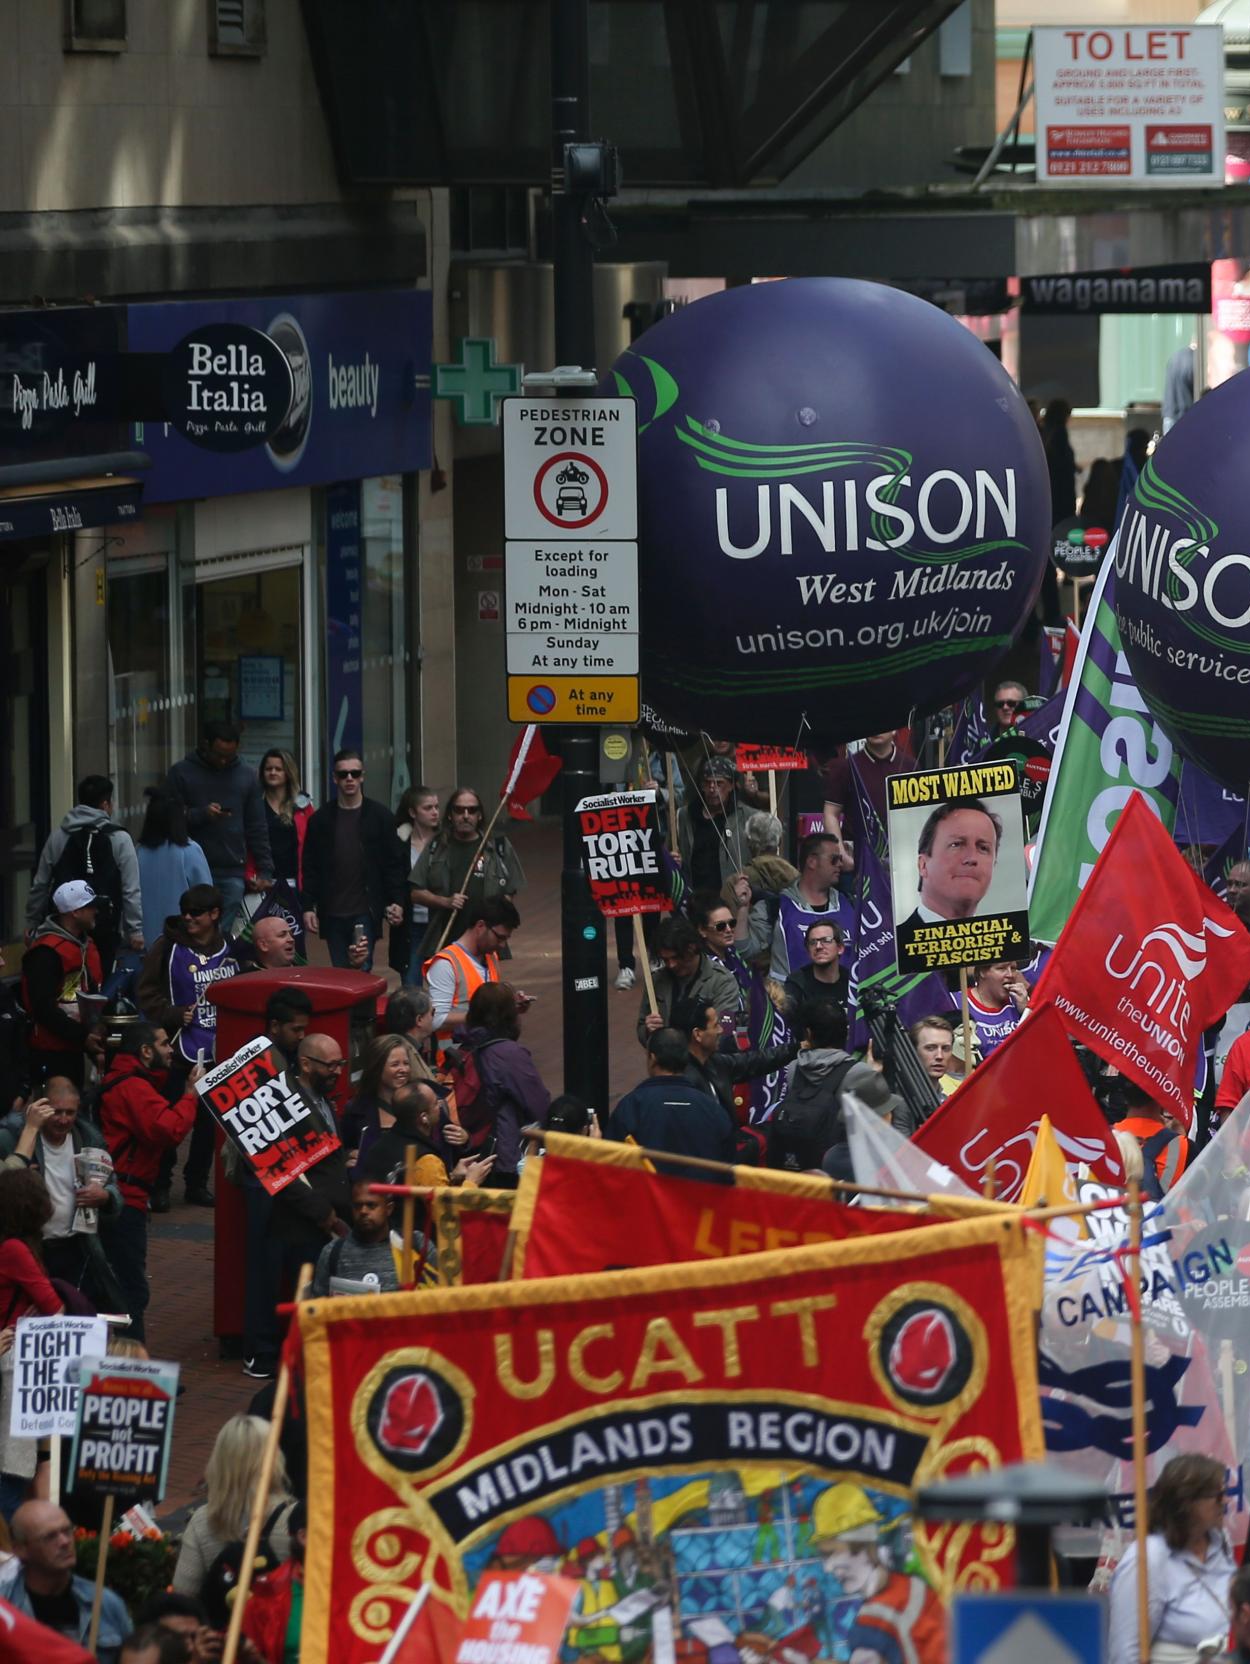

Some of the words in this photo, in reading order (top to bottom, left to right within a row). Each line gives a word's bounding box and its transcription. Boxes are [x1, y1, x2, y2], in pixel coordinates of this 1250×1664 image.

[1063, 31, 1114, 60] TO
[1124, 31, 1191, 60] LET
[1031, 277, 1204, 310] wagamama
[187, 343, 267, 377] Bella
[73, 361, 97, 417] Grill
[186, 380, 268, 413] Italia
[328, 352, 379, 418] beauty
[186, 420, 210, 436] Pizza
[214, 420, 239, 433] Pasta
[244, 419, 267, 434] Grill
[519, 408, 620, 422] PEDESTRIAN
[533, 426, 606, 446] ZONE
[715, 468, 1017, 560] UNISON
[534, 549, 586, 565] Except
[588, 549, 609, 562] for
[545, 565, 598, 580] loading
[796, 573, 877, 606] West
[888, 562, 1016, 600] Midlands
[538, 586, 570, 597] Mon
[581, 585, 606, 598] Sat
[514, 602, 579, 617] Midnight
[588, 602, 608, 615] 10
[608, 604, 630, 615] am
[517, 618, 527, 630] 6
[529, 620, 553, 632] pm
[563, 617, 628, 632] Midnight
[735, 606, 992, 654] unison.org.uk/join
[1128, 616, 1163, 658] public
[546, 636, 600, 651] Sunday
[531, 655, 550, 667] At
[552, 658, 578, 670] any
[584, 655, 615, 667] time
[568, 689, 586, 701] At
[588, 690, 614, 703] any
[575, 703, 607, 716] time
[891, 774, 940, 804] MOST
[942, 765, 1016, 799] WANTED
[582, 797, 617, 809] Socialist
[618, 795, 646, 805] Worker
[580, 805, 651, 834] DEFY
[582, 828, 653, 857] TORY
[588, 852, 659, 880] RULE
[905, 932, 1007, 956] TERRORIST
[1011, 931, 1022, 943] &
[913, 918, 1013, 941] FINANCIAL
[926, 946, 1004, 967] FASCIST
[192, 965, 236, 983] UNISON
[1105, 933, 1191, 1043] unite
[204, 1057, 240, 1087] Socialist
[236, 1043, 262, 1065] Worker
[209, 1050, 279, 1112] DEFY
[221, 1070, 293, 1133] TORY
[238, 1092, 312, 1157] RULE
[28, 1321, 64, 1331] Socialist
[20, 1331, 86, 1359] FIGHT
[494, 1294, 837, 1400] UCATT
[19, 1358, 60, 1386] THE
[19, 1386, 79, 1414] TORIE
[83, 1395, 166, 1429] PEOPLE
[21, 1417, 55, 1430] Defend
[111, 1426, 133, 1442] not
[80, 1441, 159, 1473] PROFIT
[456, 1413, 694, 1520] MIDLANDS
[728, 1411, 896, 1471] REGION
[474, 1574, 548, 1622] AXE
